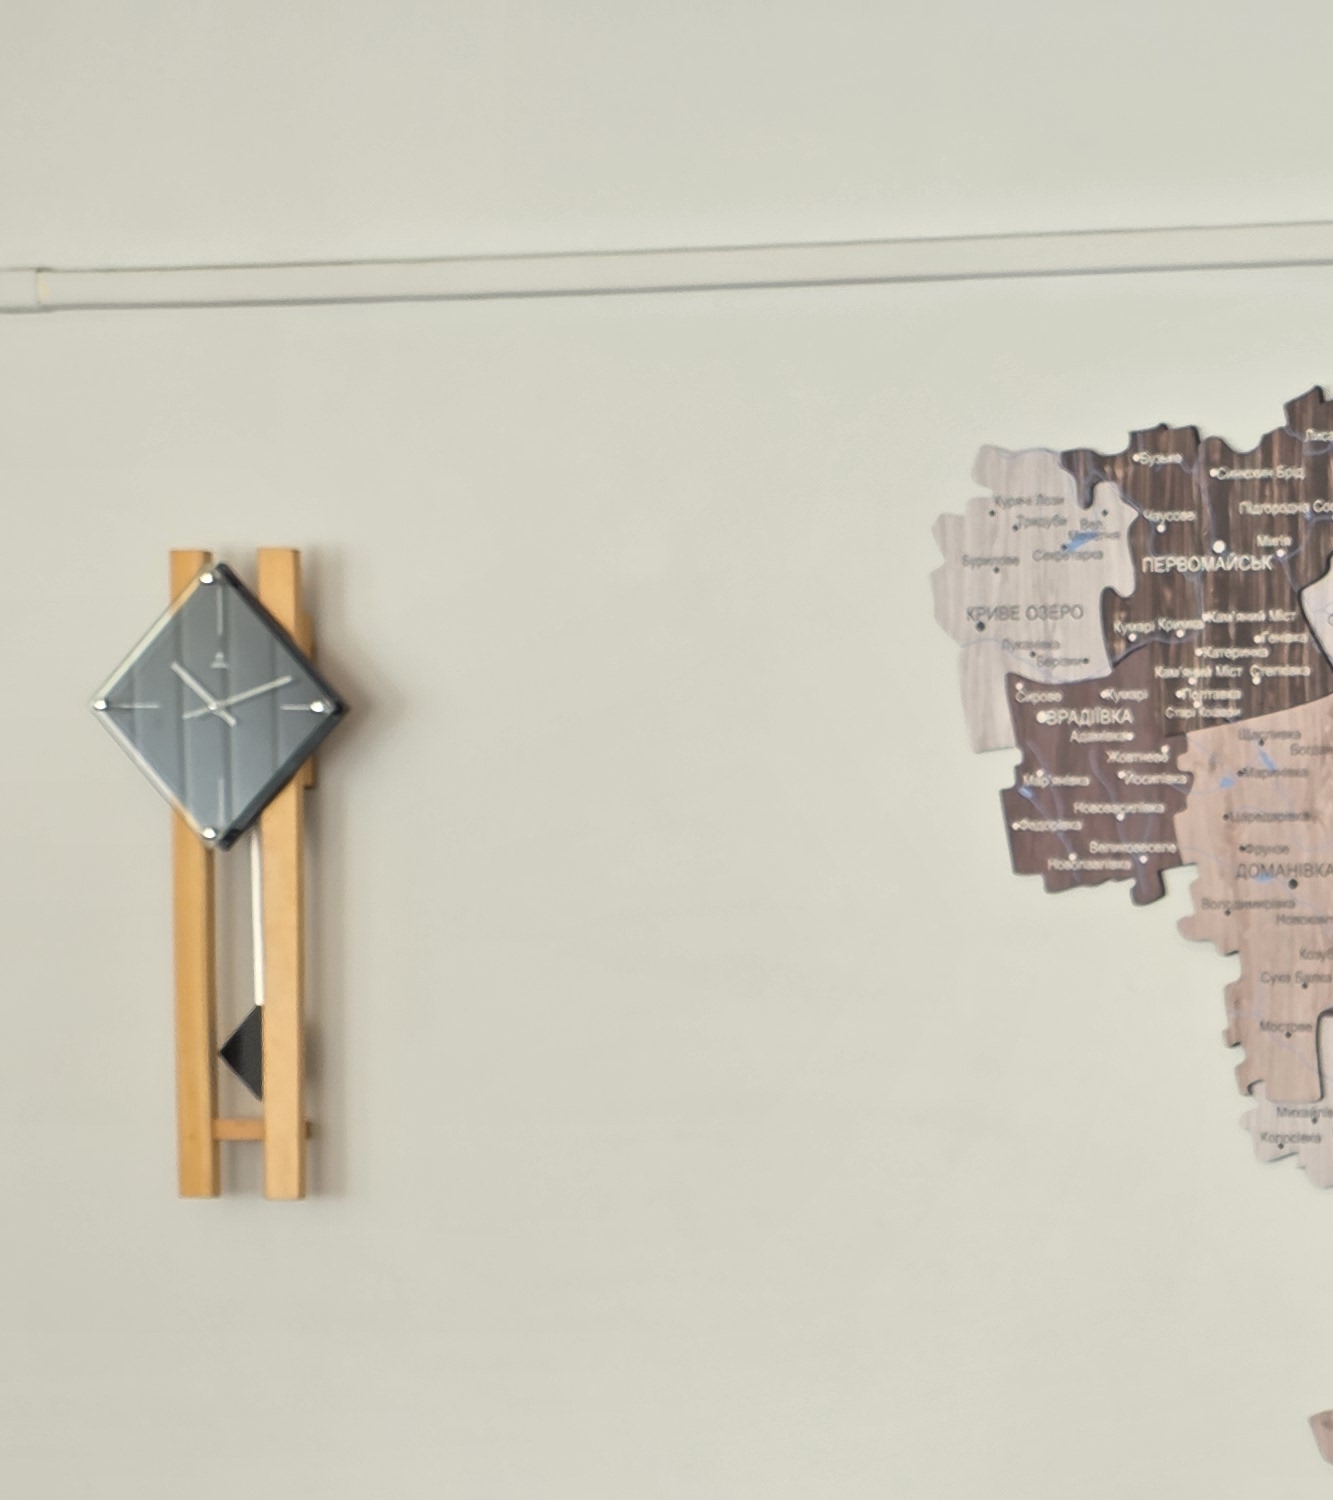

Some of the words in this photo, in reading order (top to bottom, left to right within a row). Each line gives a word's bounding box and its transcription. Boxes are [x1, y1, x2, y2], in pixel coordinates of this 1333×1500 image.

[1142, 552, 1274, 573] ПЕРВОМАЙСЬК
[967, 604, 1020, 622] КРИВЕ
[1027, 604, 1083, 621] ОЗЕРО
[1046, 708, 1133, 725] ВРАДІЇВКА
